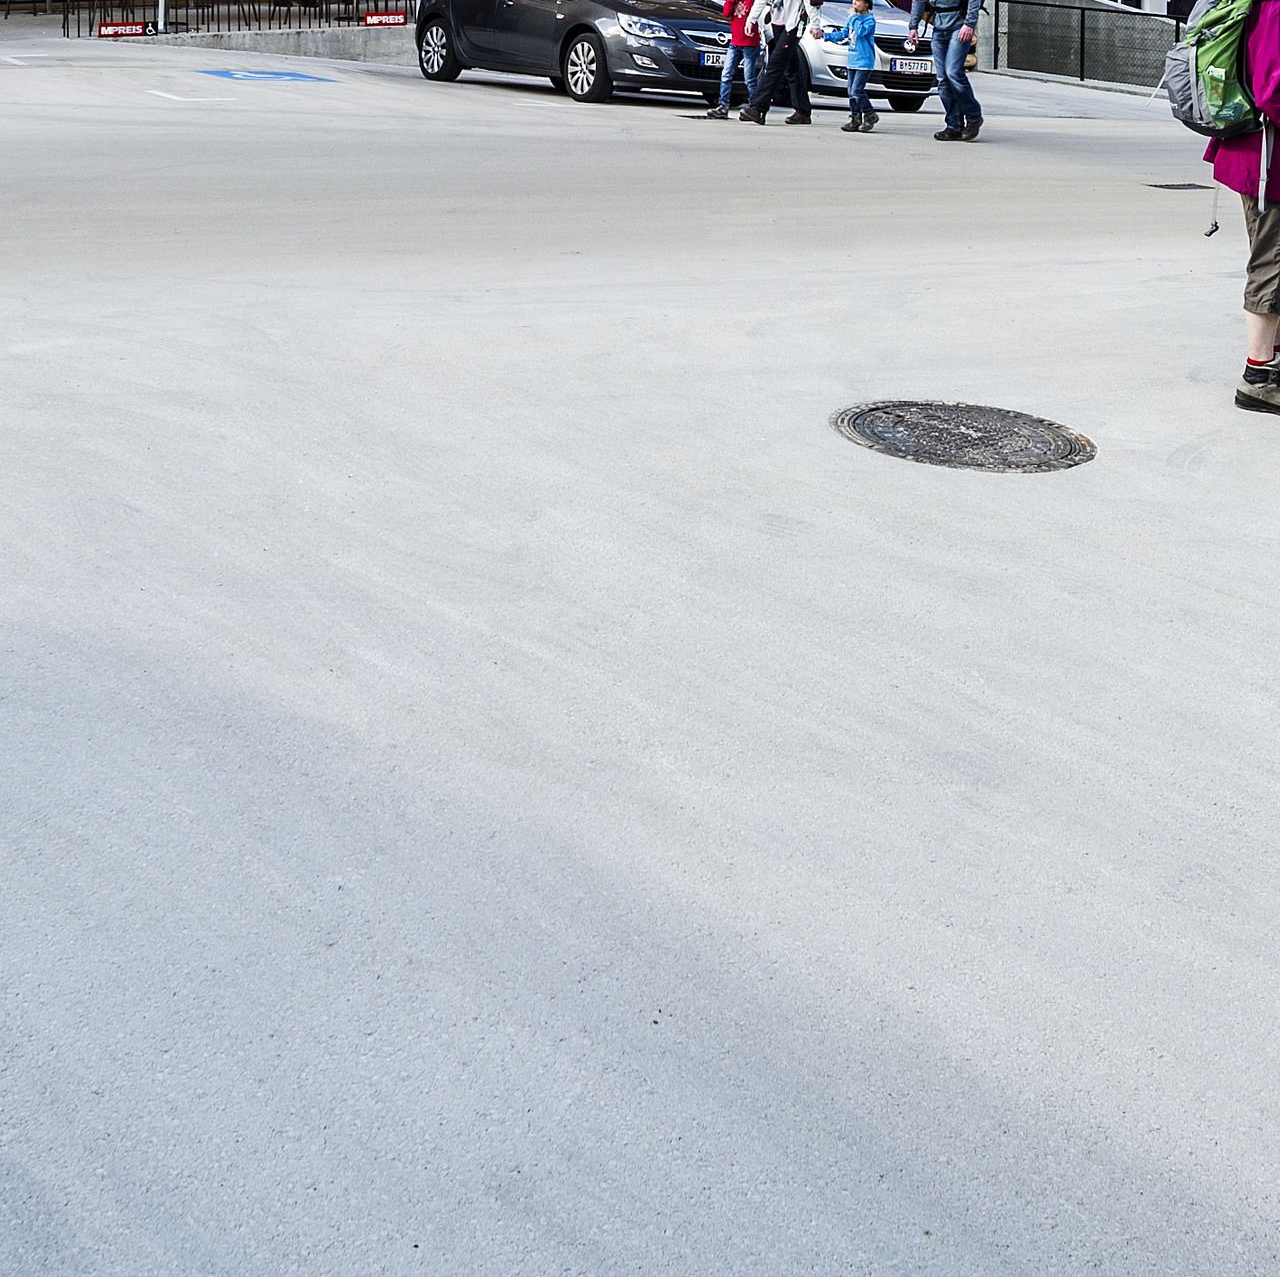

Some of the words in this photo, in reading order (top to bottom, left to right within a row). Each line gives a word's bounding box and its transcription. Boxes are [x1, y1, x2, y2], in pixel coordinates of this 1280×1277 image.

[366, 15, 405, 25] MPREIS
[101, 25, 142, 34] MPREIS
[706, 55, 721, 64] PIR
